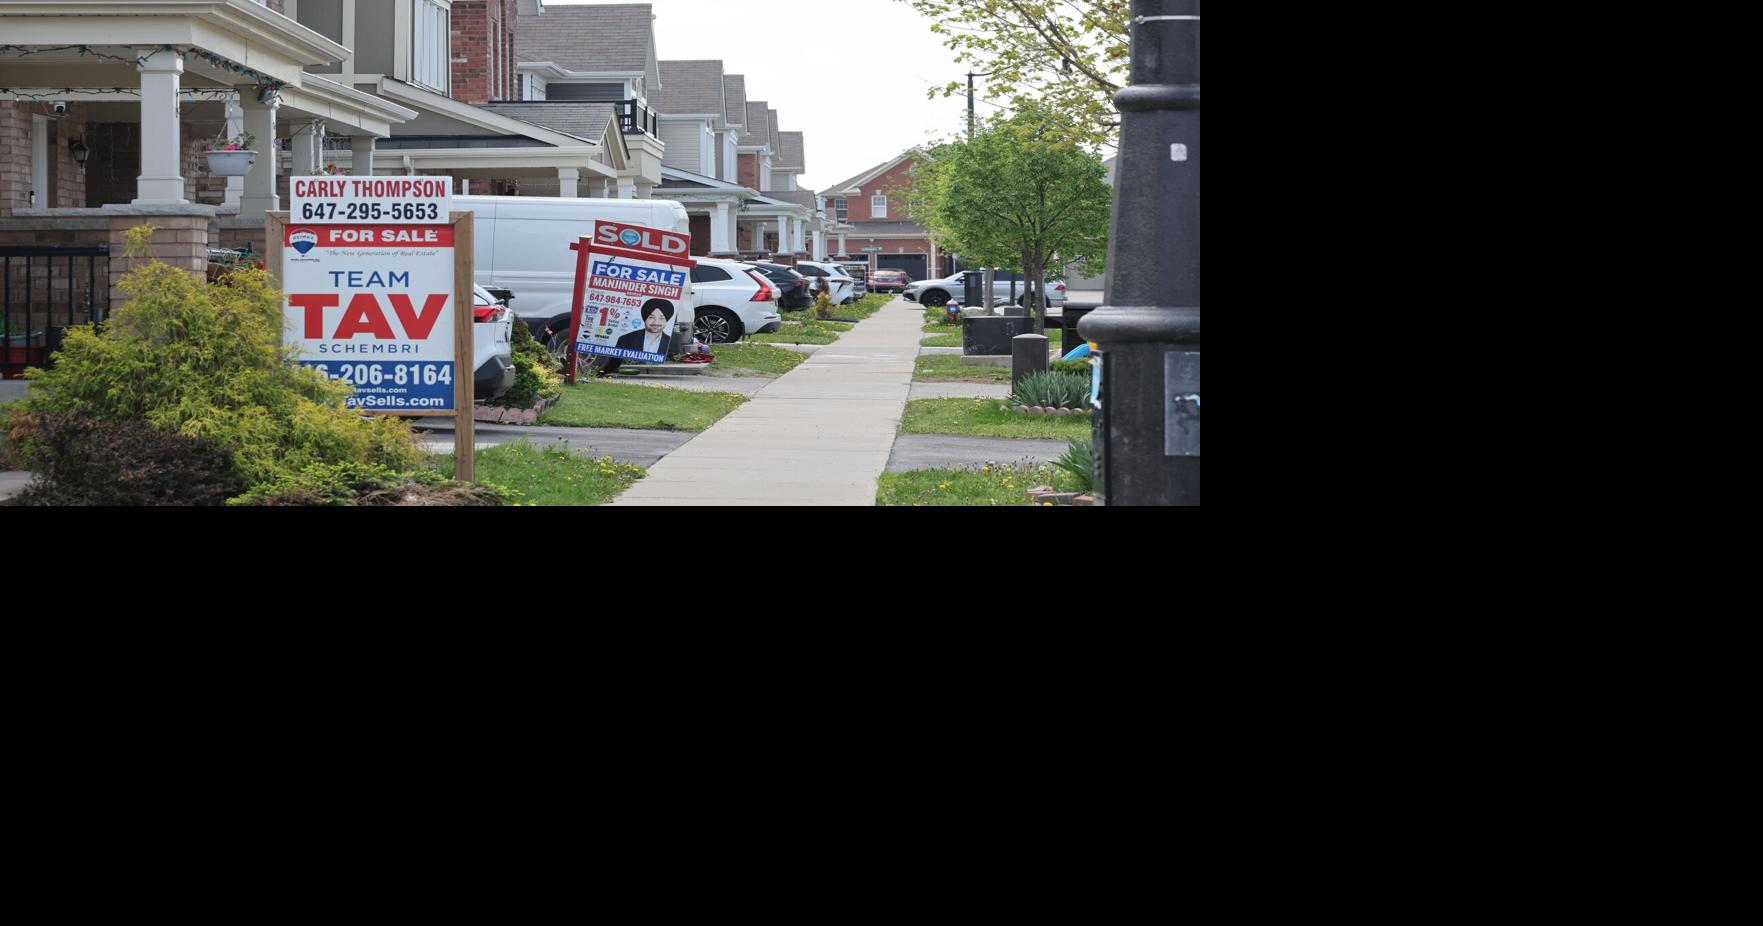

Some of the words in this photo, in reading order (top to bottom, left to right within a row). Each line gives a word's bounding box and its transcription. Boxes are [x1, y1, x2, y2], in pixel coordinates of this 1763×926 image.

[295, 180, 347, 198] CARLY
[353, 180, 446, 198] THOMPSON
[302, 203, 438, 220] 647-295-5653
[329, 230, 374, 242] FOR
[381, 230, 438, 242] SALE
[598, 225, 687, 254] SOLD
[329, 271, 409, 288] TEAM
[595, 263, 632, 280] FOR
[635, 269, 682, 286] SALE
[592, 277, 648, 293] MANJINDER
[648, 284, 679, 298] SINGH
[589, 293, 642, 308] 647-984-7653
[288, 293, 449, 340] TAV
[319, 343, 419, 354] SCHEMBRI
[577, 343, 594, 353] FREE
[594, 345, 623, 357] MARKET
[622, 348, 665, 363] EVALUATION
[304, 364, 452, 385] 6-206-8164
